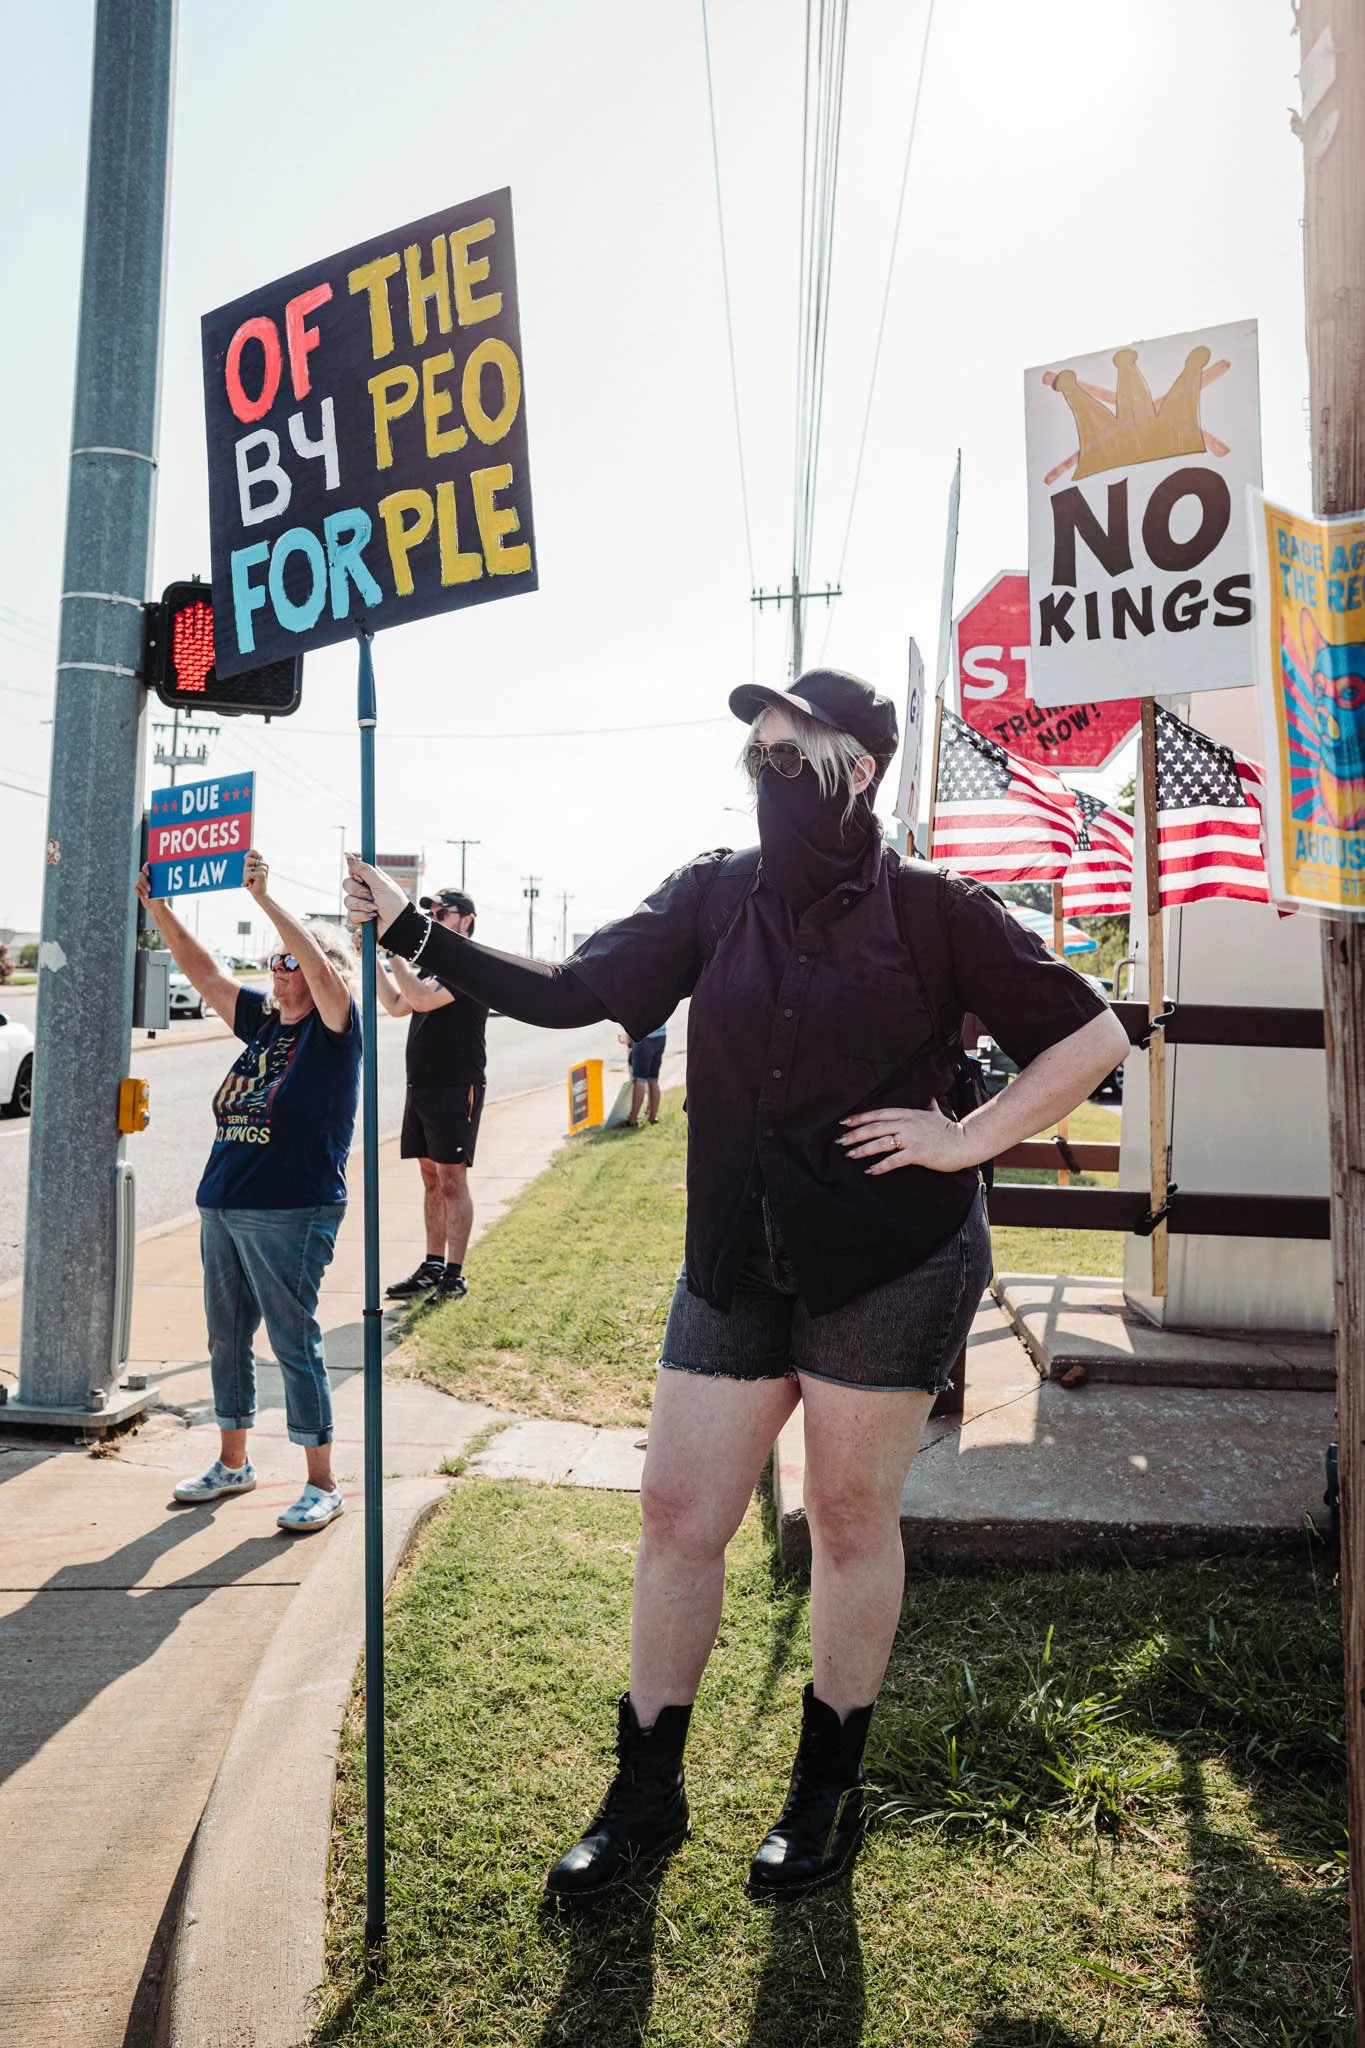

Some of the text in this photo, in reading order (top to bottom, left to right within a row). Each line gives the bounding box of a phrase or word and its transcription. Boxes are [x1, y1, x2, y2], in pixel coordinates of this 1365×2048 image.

[224, 217, 503, 424] OF THE
[235, 337, 522, 527] BY PEO
[1050, 467, 1231, 588] NO
[1278, 527, 1325, 573] RAGE
[230, 463, 532, 654] FOR PLE
[1039, 573, 1254, 647] KINGS
[1280, 562, 1365, 614] THE RE
[962, 645, 1034, 700] ST
[994, 699, 1075, 744] TRU
[1036, 703, 1101, 751] NOW!
[181, 784, 219, 815] DUE
[159, 820, 240, 856] PROCESS
[168, 859, 228, 891] IS LAW
[225, 1126, 271, 1144] KINGS
[227, 1115, 249, 1124] SERVE
